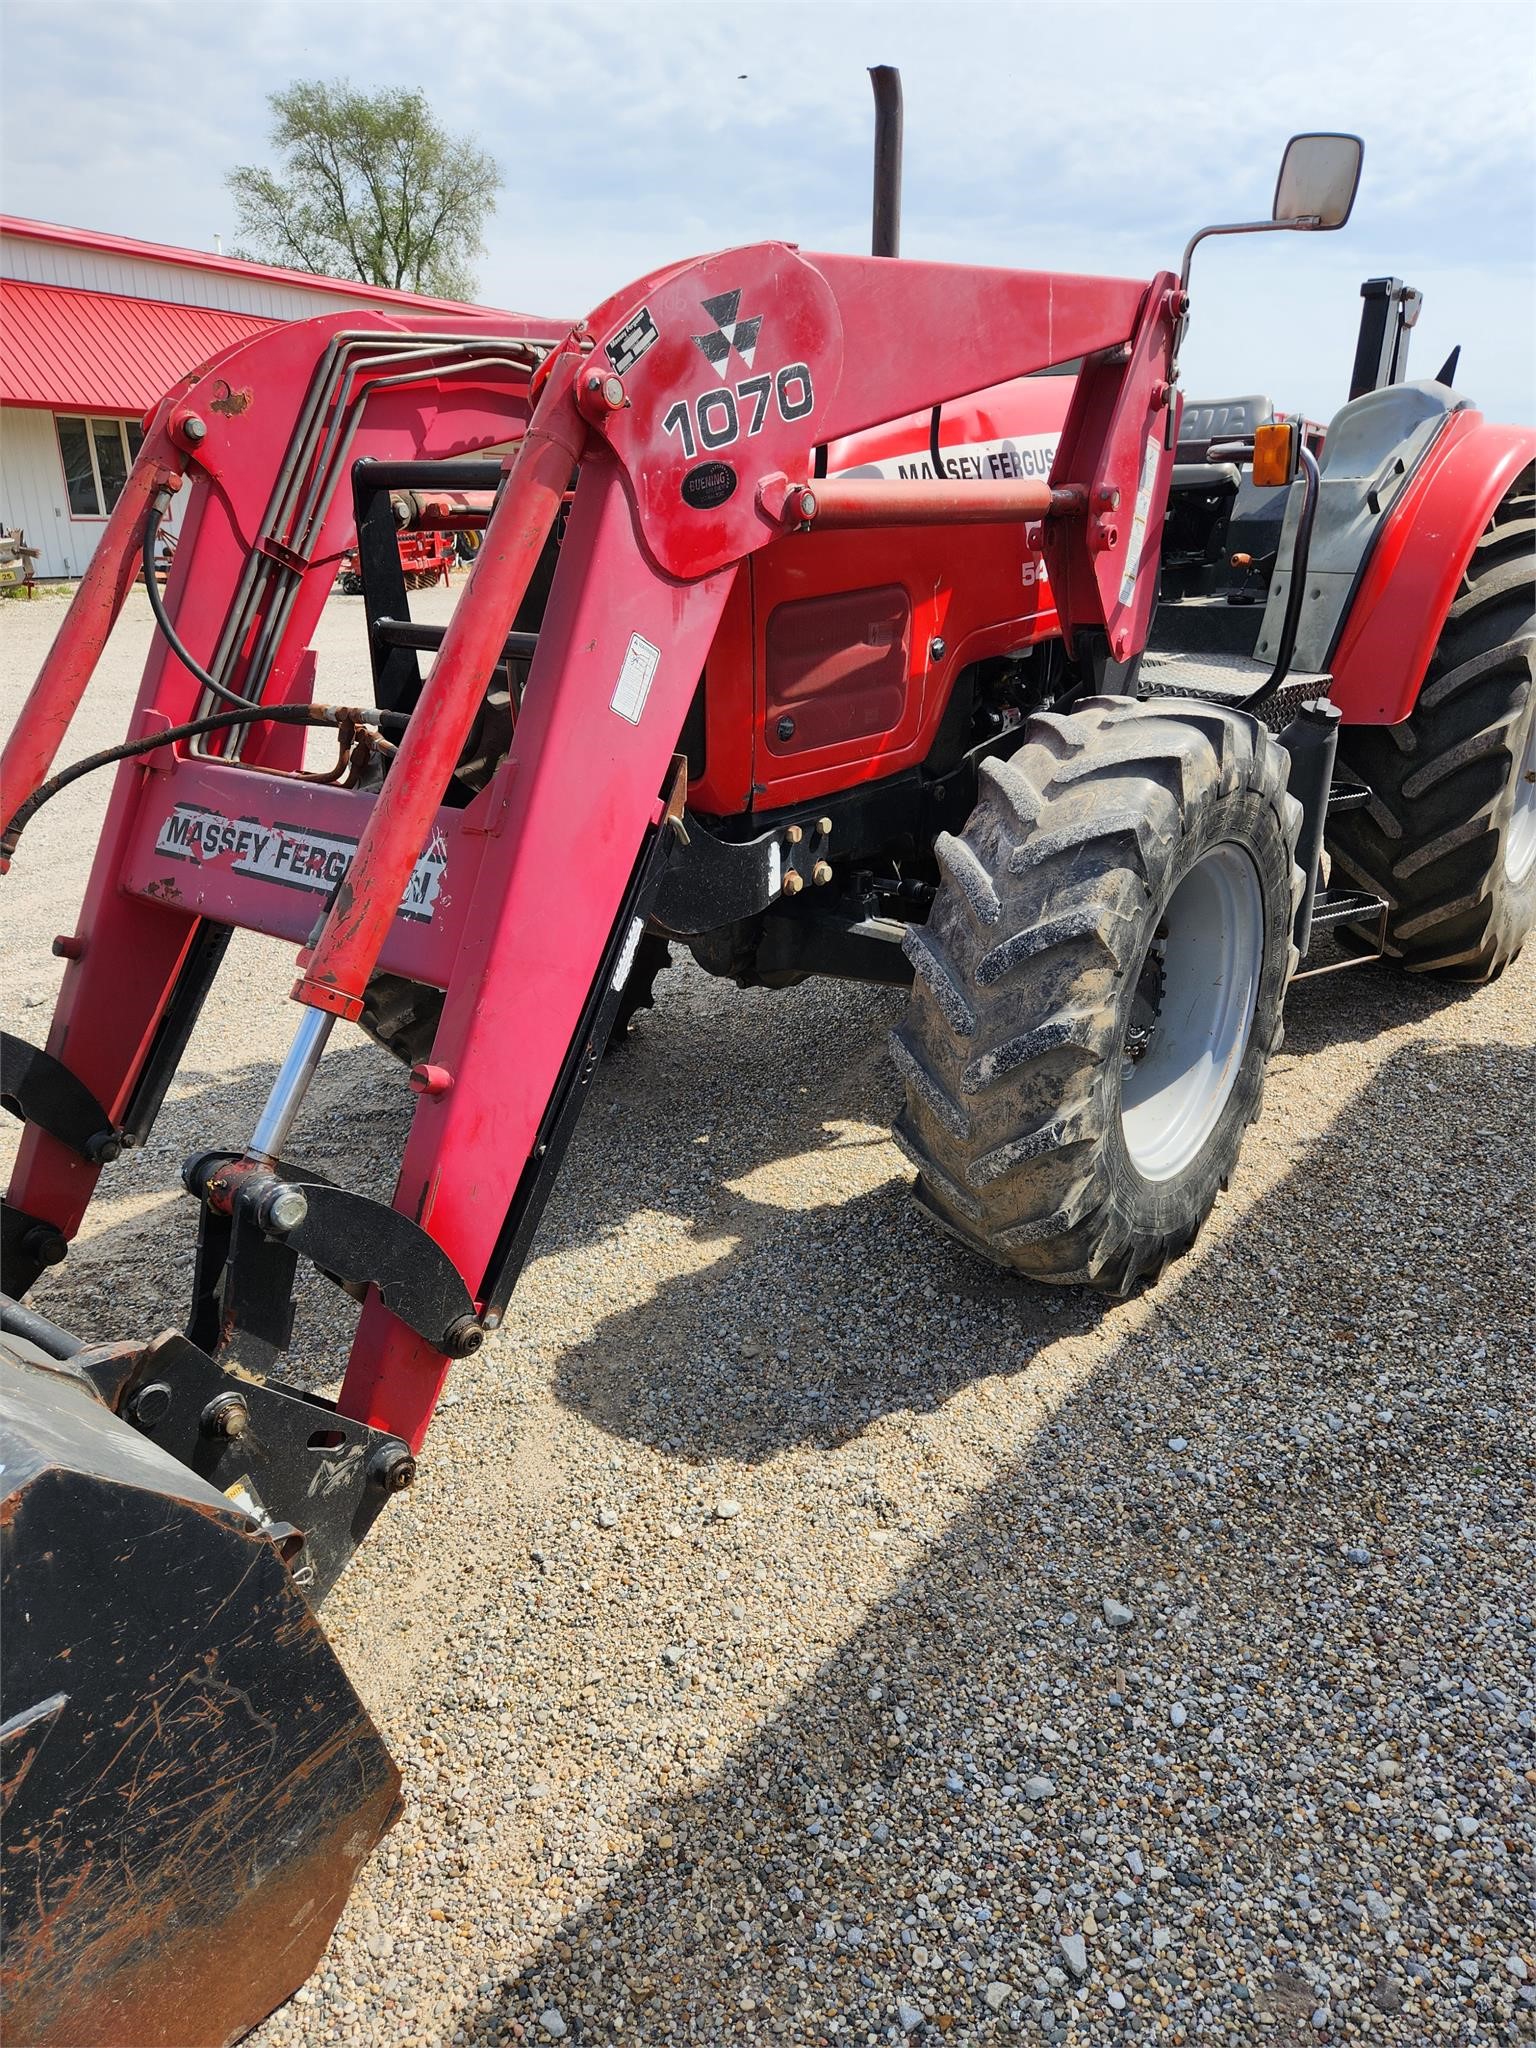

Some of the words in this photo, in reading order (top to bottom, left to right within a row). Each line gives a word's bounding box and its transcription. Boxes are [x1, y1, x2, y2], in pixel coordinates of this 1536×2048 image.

[661, 362, 815, 460] 1070
[688, 471, 726, 492] BUENING
[898, 456, 983, 480] MASEY
[166, 815, 270, 863] MASSEY
